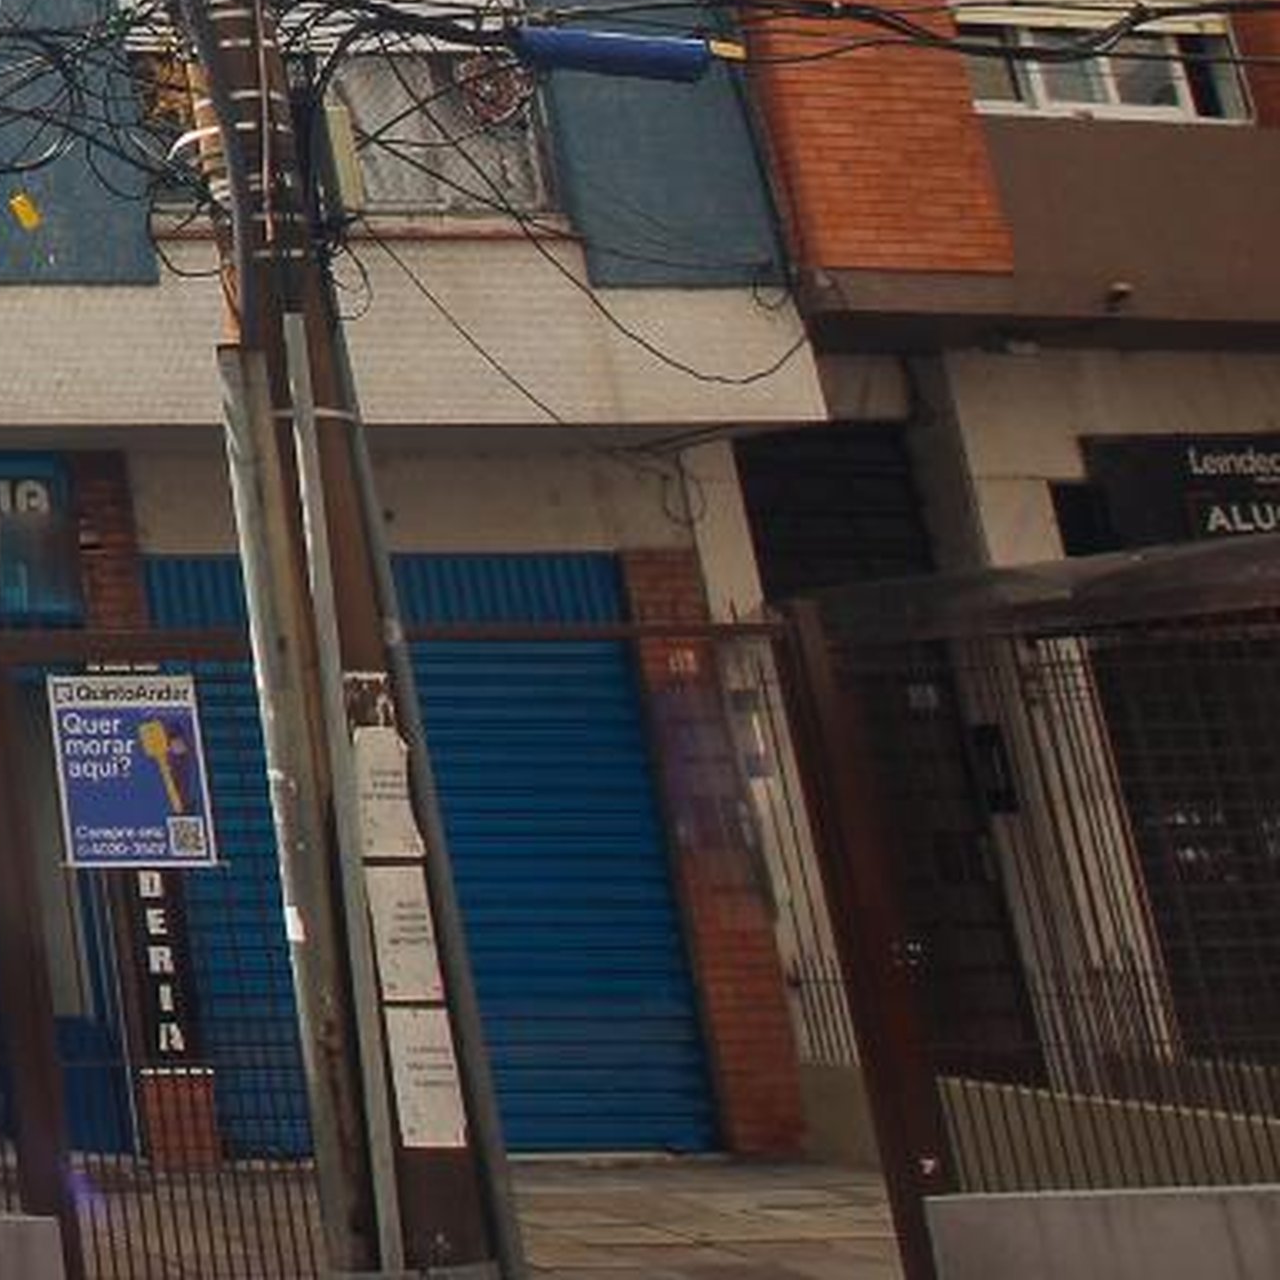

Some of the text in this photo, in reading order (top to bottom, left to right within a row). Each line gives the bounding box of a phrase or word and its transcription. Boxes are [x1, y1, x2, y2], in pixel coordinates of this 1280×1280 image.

[62, 712, 122, 736] Quer
[64, 737, 137, 757] morar
[68, 756, 133, 781] aqui?
